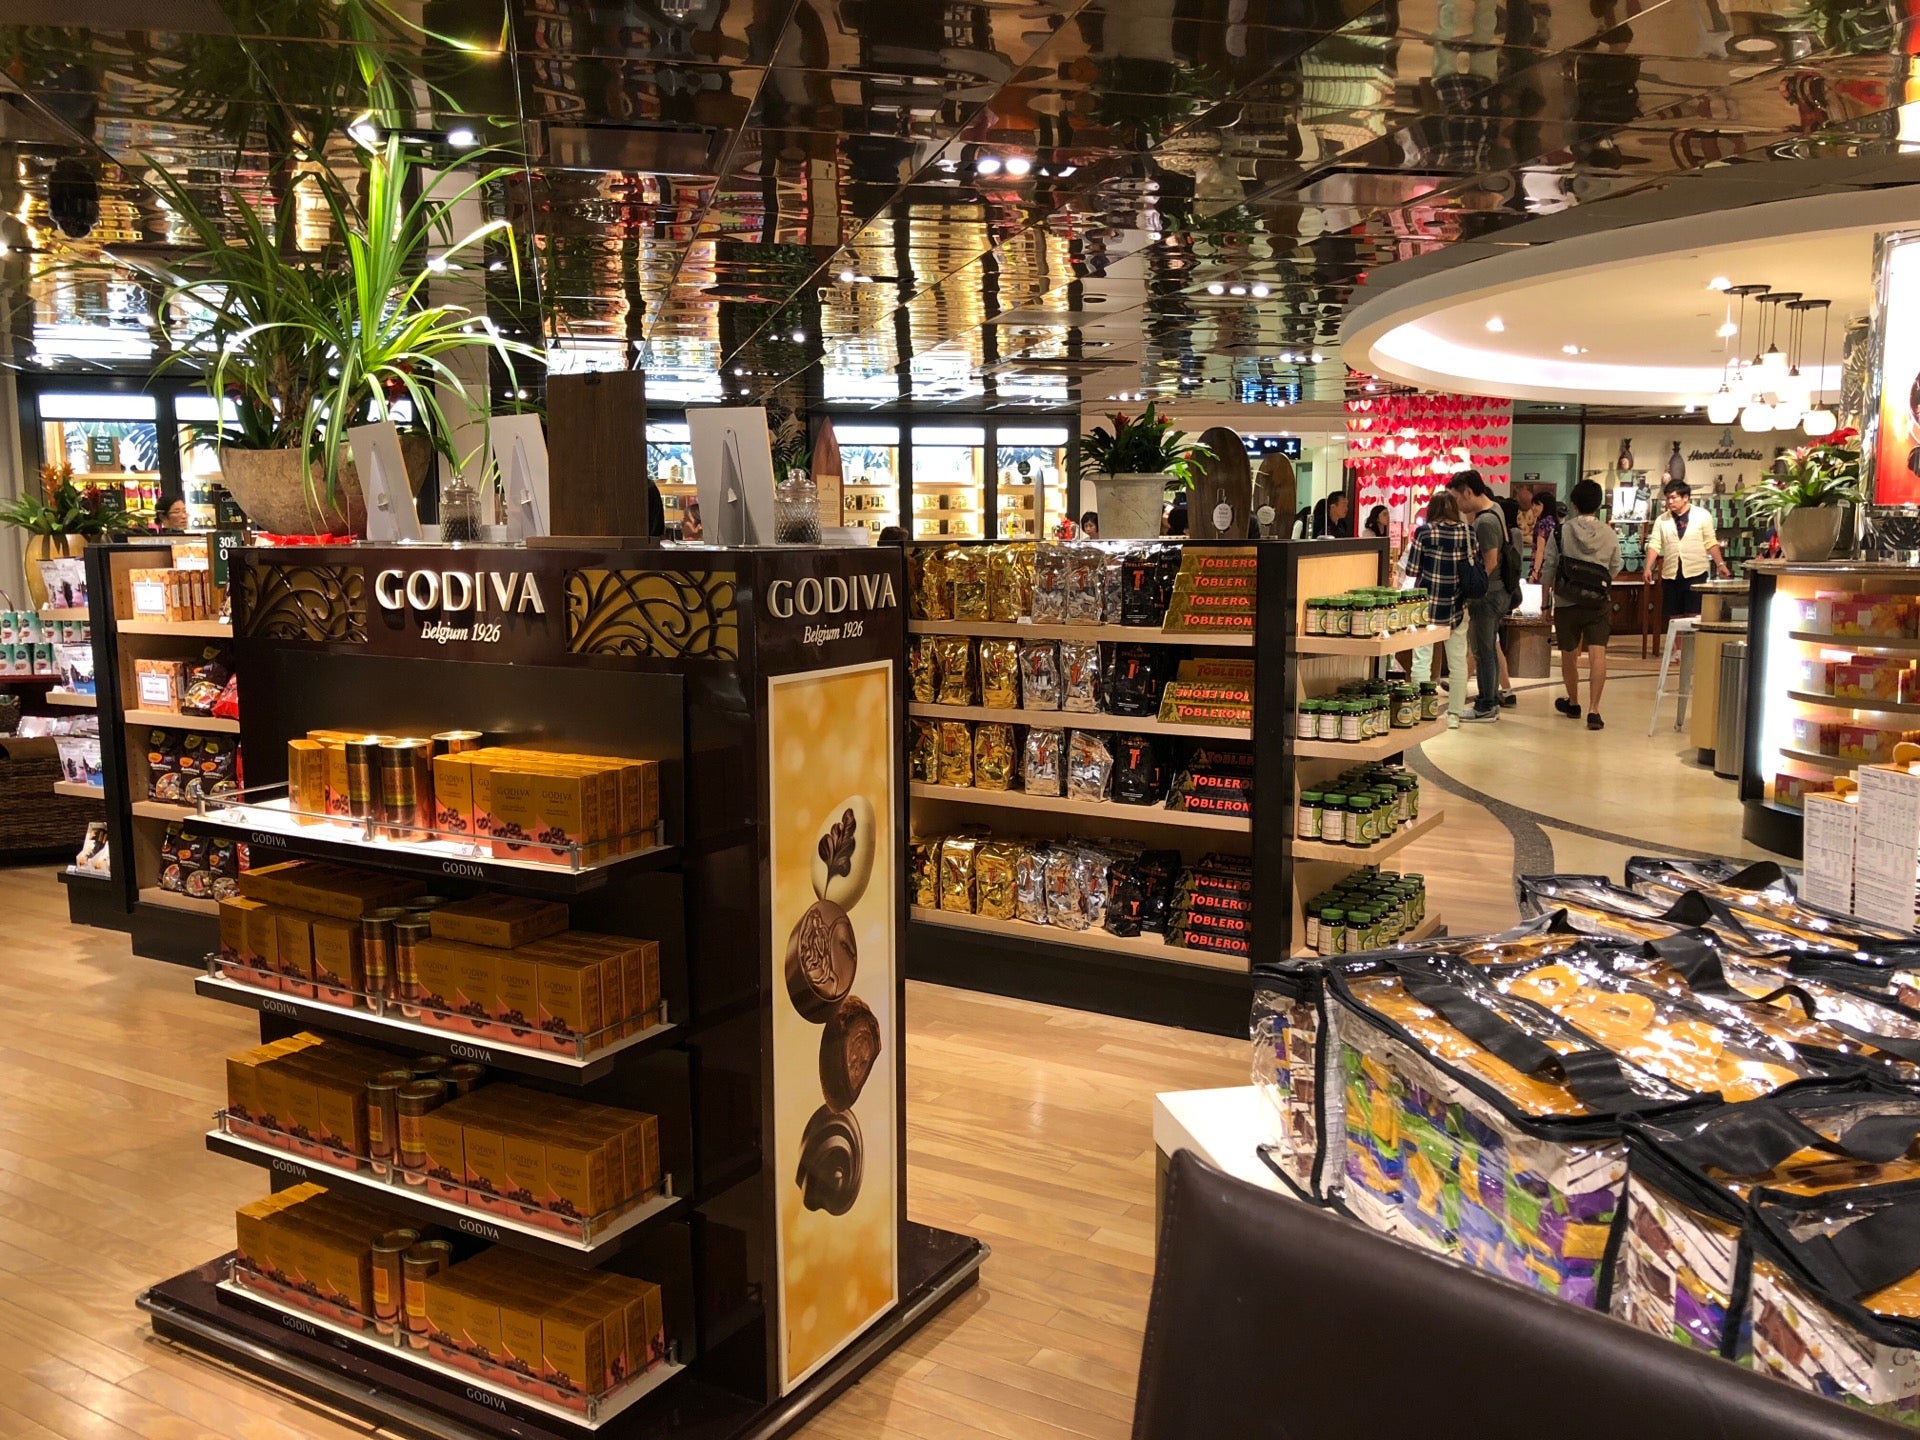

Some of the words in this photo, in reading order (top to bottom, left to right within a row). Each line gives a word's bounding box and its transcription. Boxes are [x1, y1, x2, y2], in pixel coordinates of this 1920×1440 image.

[1688, 448, 1732, 461] Honolulu
[1733, 448, 1763, 460] Cookie
[219, 536, 238, 548] 30%
[375, 569, 546, 614] GODIVA
[767, 572, 897, 618] GODIVA
[421, 621, 468, 644] Belgium
[471, 622, 501, 643] 1926
[803, 625, 840, 646] Belgium
[842, 620, 864, 638] 1926
[497, 786, 530, 797] GODIVA
[542, 790, 572, 801] GODIVA
[252, 832, 287, 848] GODIVA
[442, 861, 484, 878] GODIVA
[263, 999, 297, 1016] GODIVA
[450, 1044, 492, 1062] GODIVA
[273, 1159, 307, 1178] GODIVA
[459, 1219, 500, 1240] GODIVA
[283, 1315, 316, 1337] GODIVA
[466, 1388, 507, 1411] GODIVA
